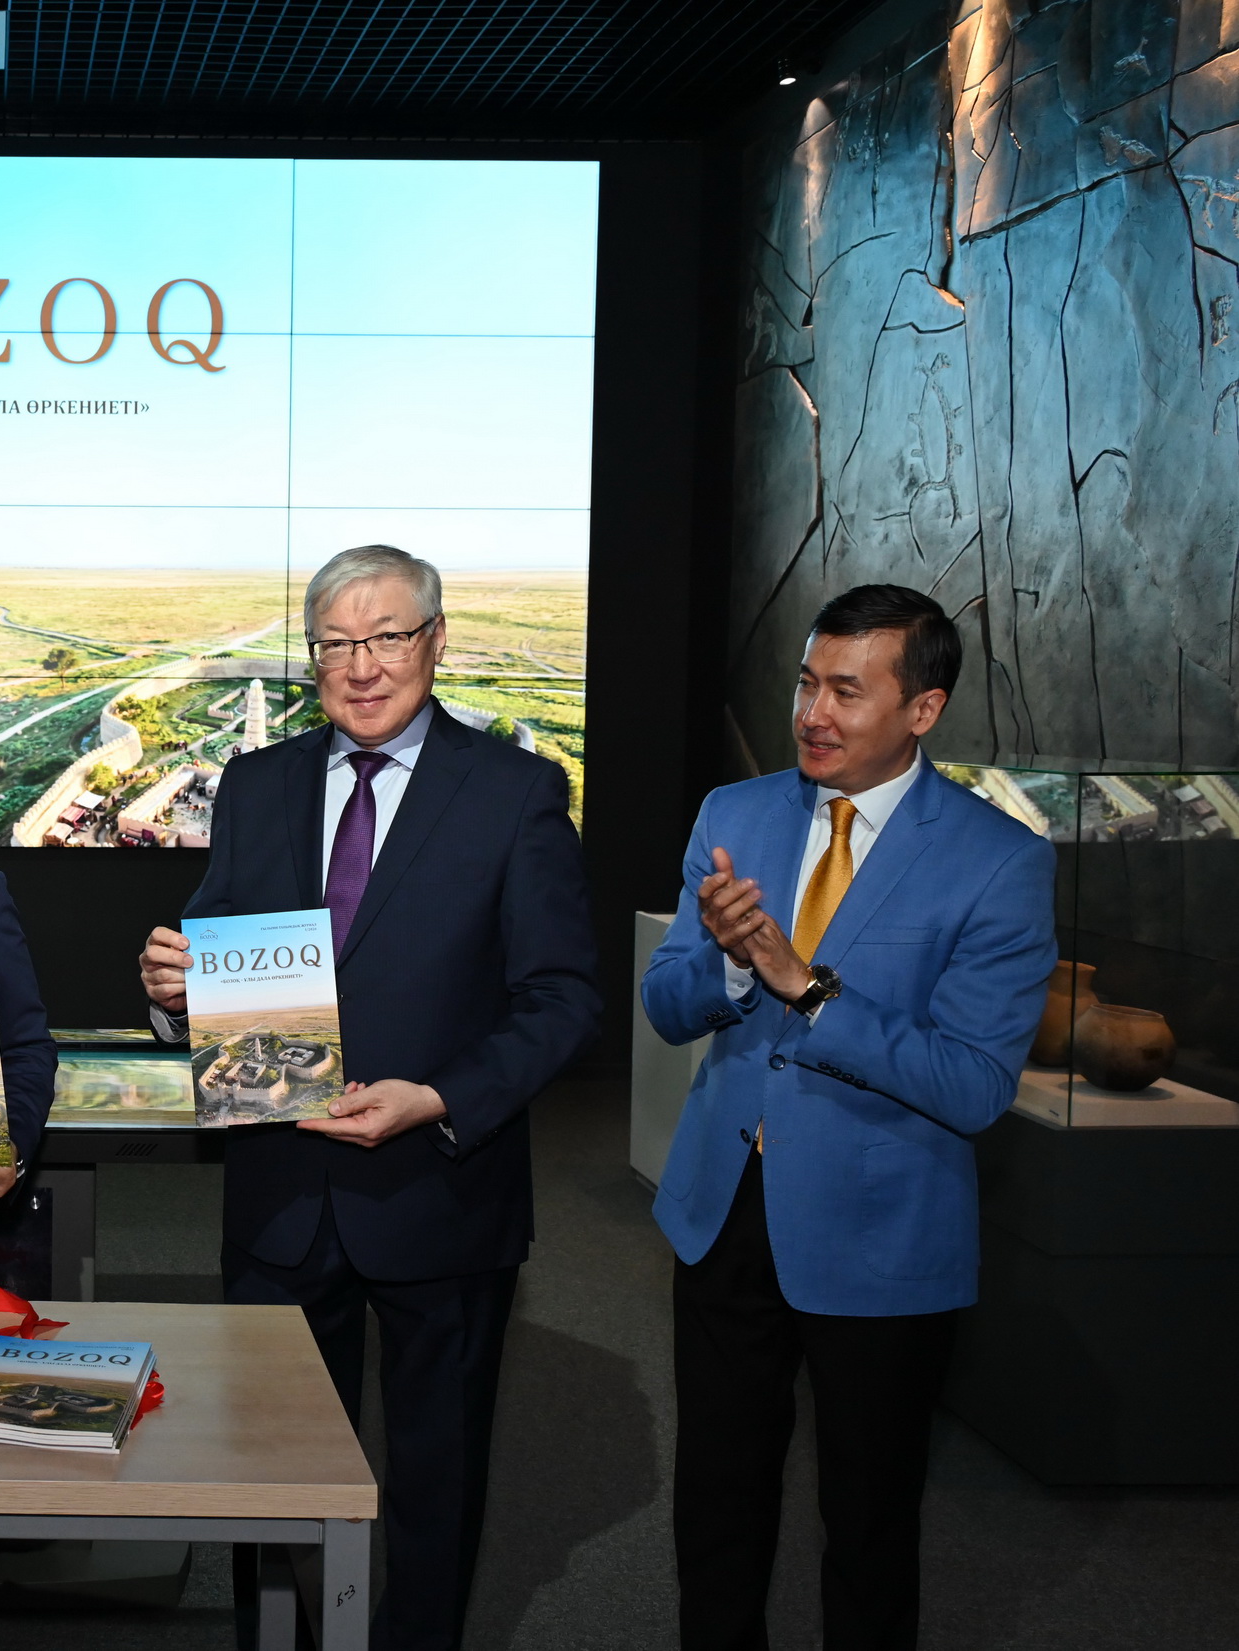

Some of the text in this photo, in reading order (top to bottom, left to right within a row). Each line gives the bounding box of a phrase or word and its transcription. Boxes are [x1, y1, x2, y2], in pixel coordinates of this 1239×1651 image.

[26, 399, 150, 416] ӨРКЕНИЕТІ»
[199, 943, 322, 975] BOZOQ
[0, 1348, 132, 1366] BOZOQ
